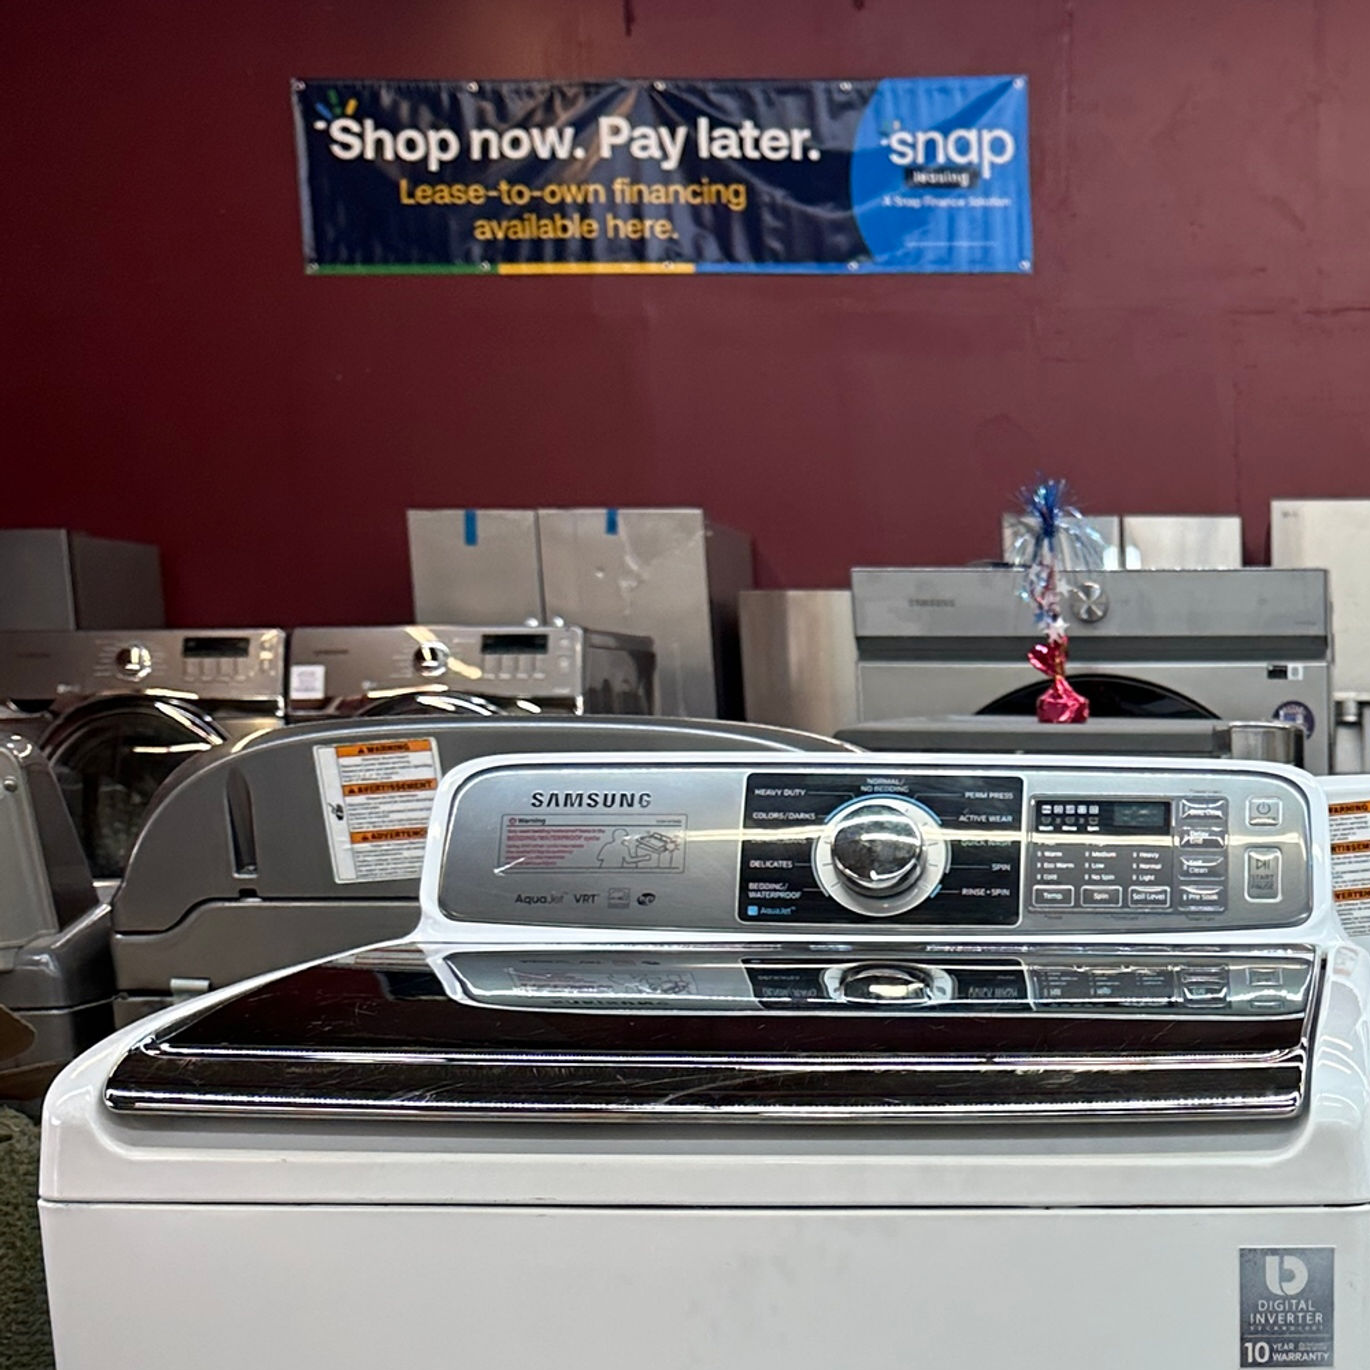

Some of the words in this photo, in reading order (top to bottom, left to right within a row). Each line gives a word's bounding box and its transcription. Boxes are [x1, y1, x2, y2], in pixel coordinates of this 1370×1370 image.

[327, 117, 460, 171] Shop
[470, 121, 587, 162] now.
[599, 117, 689, 171] Pay
[697, 117, 821, 161] later.
[889, 128, 1015, 180] snap
[399, 177, 606, 207] Lease-to-own
[613, 177, 747, 210] financing
[473, 212, 598, 241] available
[606, 213, 680, 241] here.
[366, 743, 411, 754] WARNING
[754, 788, 782, 796] HEAVY
[783, 788, 807, 796] DUTY
[964, 791, 988, 799] PERM
[989, 791, 1014, 800] PRESS
[530, 791, 653, 809] SAMSUNG
[752, 811, 816, 820] COLORS/DARKS
[958, 814, 987, 822] ACTIVE
[749, 860, 793, 869] DELICATES
[991, 863, 1011, 871] SPIN
[747, 890, 803, 899] WATERPROOF
[961, 888, 986, 897] RINSE
[991, 888, 1011, 897] SPIN
[574, 893, 599, 904] VRT
[1258, 1299, 1317, 1312] DIGITAL
[1249, 1312, 1324, 1325] INVERTER
[1243, 1341, 1270, 1364] 10
[1272, 1342, 1295, 1351] YEAR
[1271, 1351, 1330, 1362] WARRANTY
